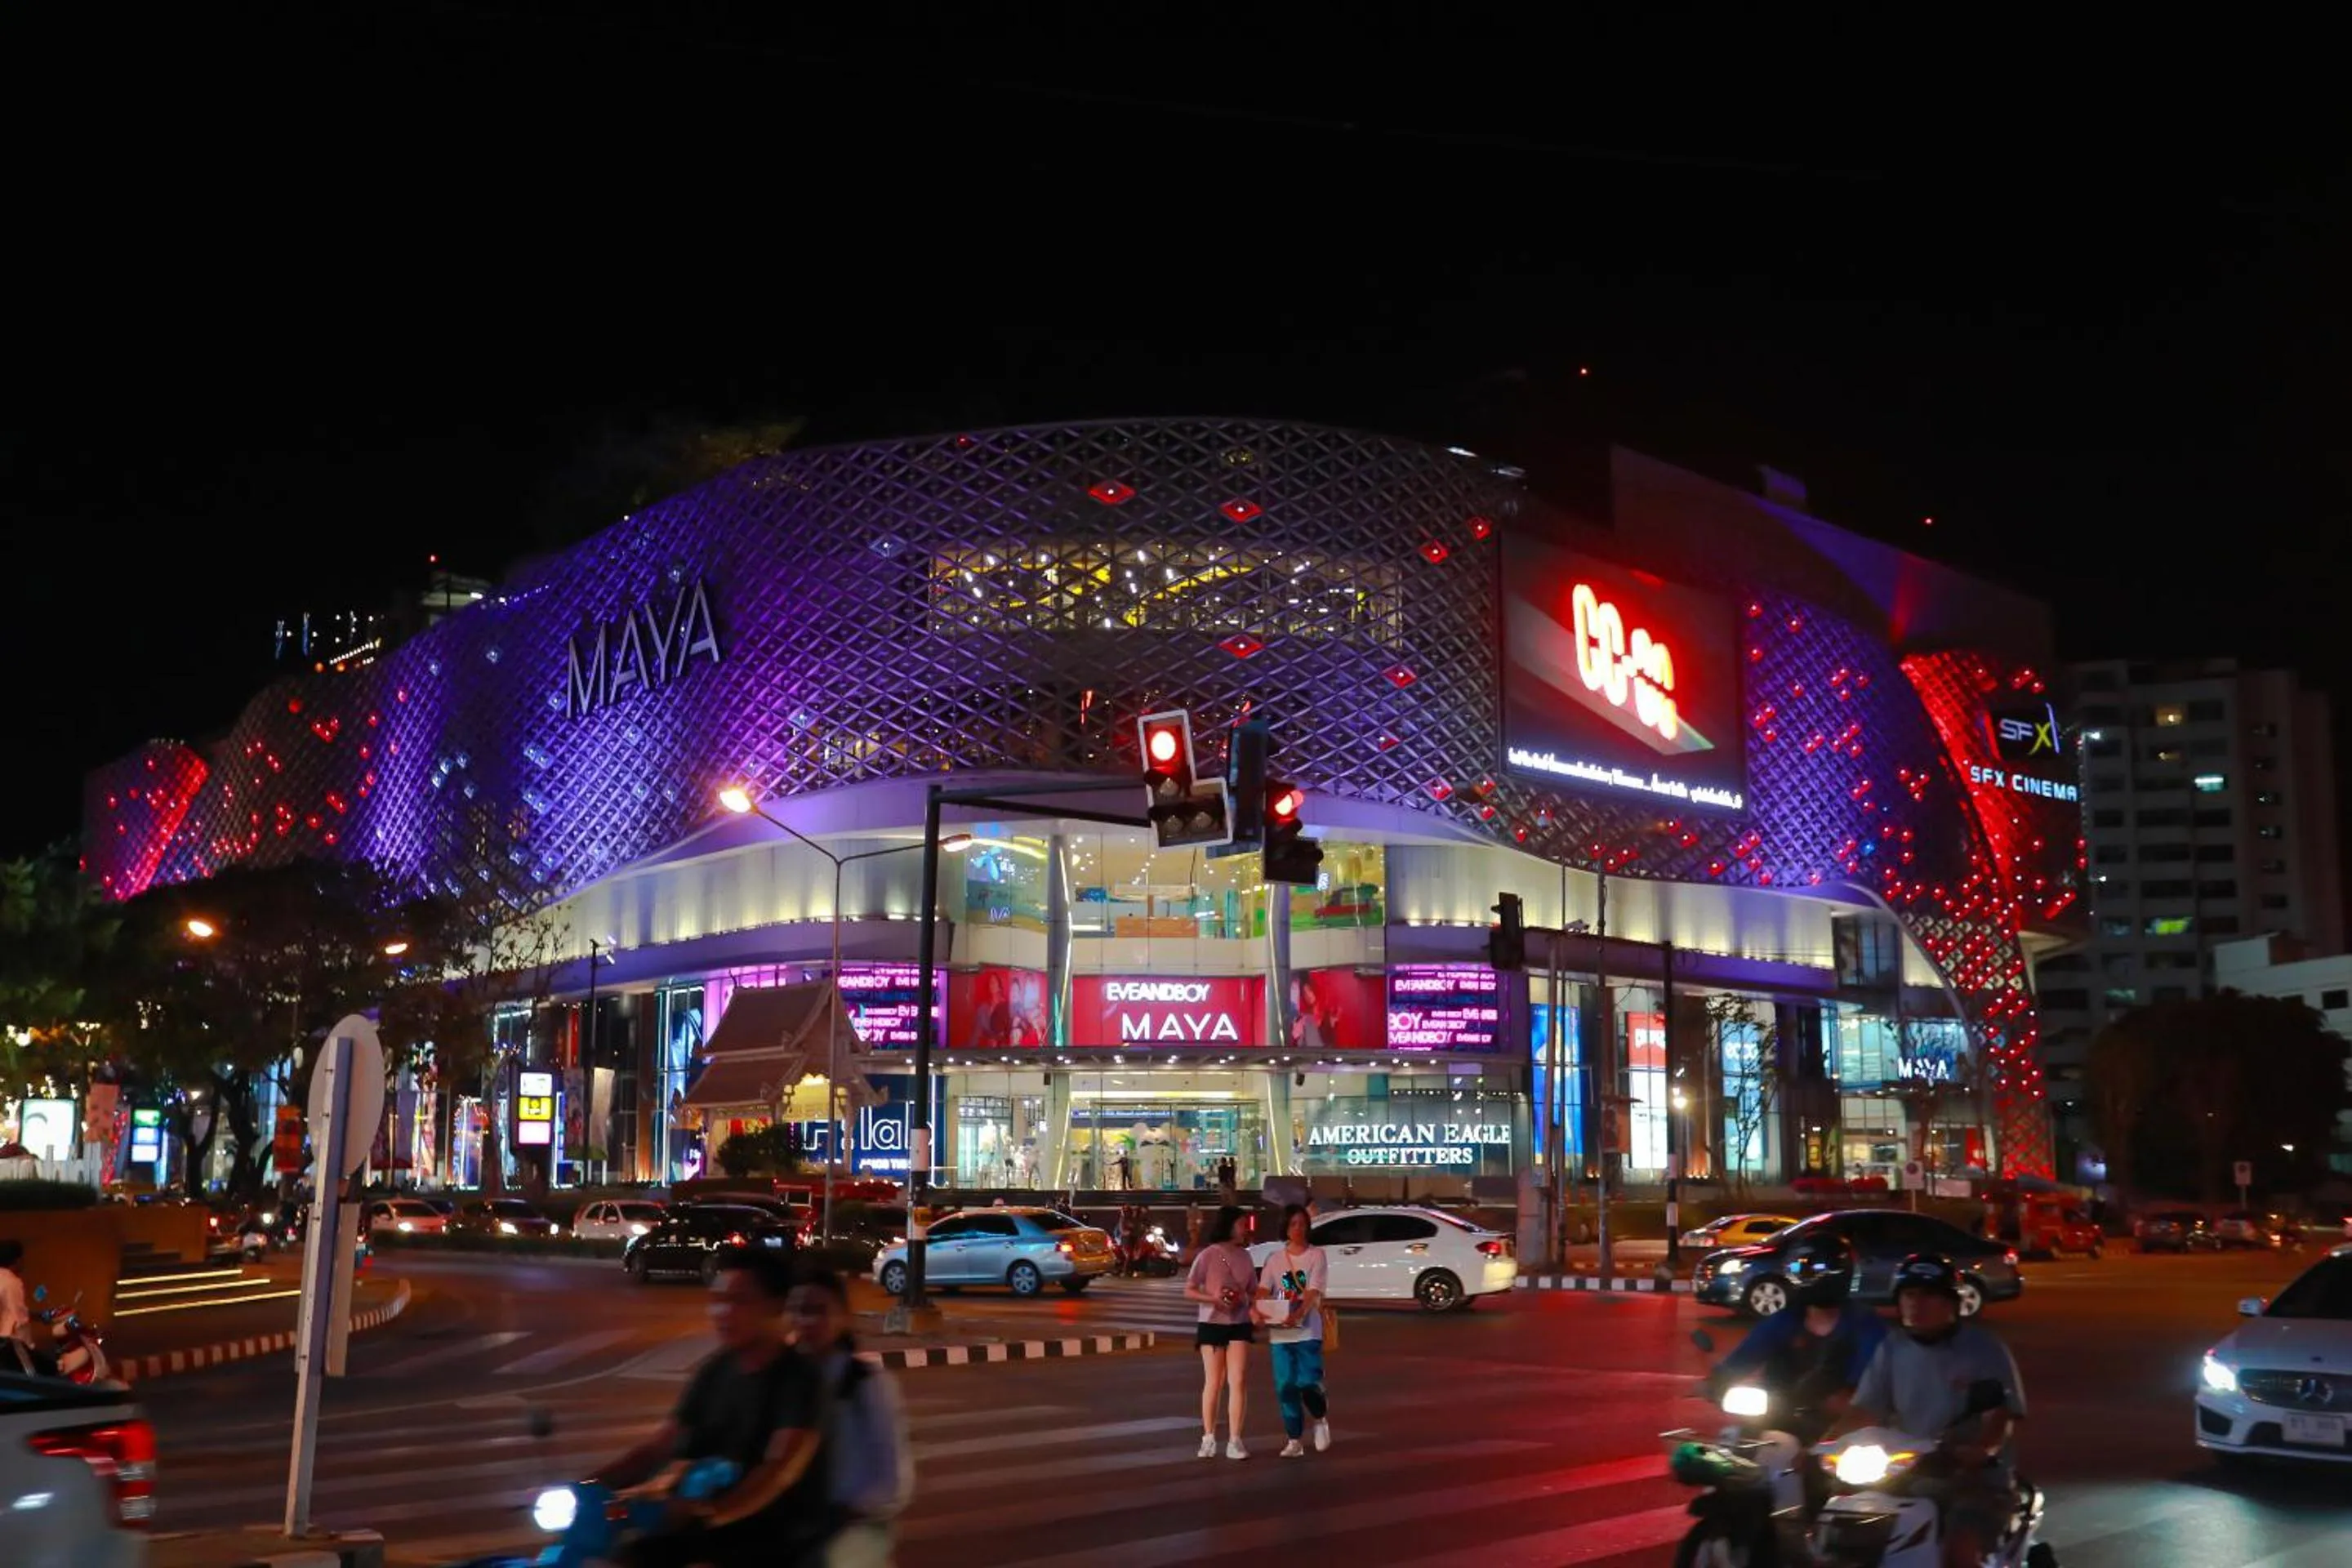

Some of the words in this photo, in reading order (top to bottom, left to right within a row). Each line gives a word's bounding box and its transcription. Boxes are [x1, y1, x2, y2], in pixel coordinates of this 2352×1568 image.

[567, 578, 719, 719] MAYA
[1999, 718, 2053, 755] SFX
[1970, 765, 2005, 788] SFX
[2011, 773, 2078, 802] CINEMA
[1107, 982, 1211, 1002] EVEANDBOY
[1122, 1013, 1239, 1040] MAYA
[1897, 1056, 1950, 1080] MAYA
[1308, 1124, 1436, 1145] AMERICAN
[1443, 1124, 1510, 1144] EAGLE
[1348, 1147, 1473, 1165] OUTFITTERS
